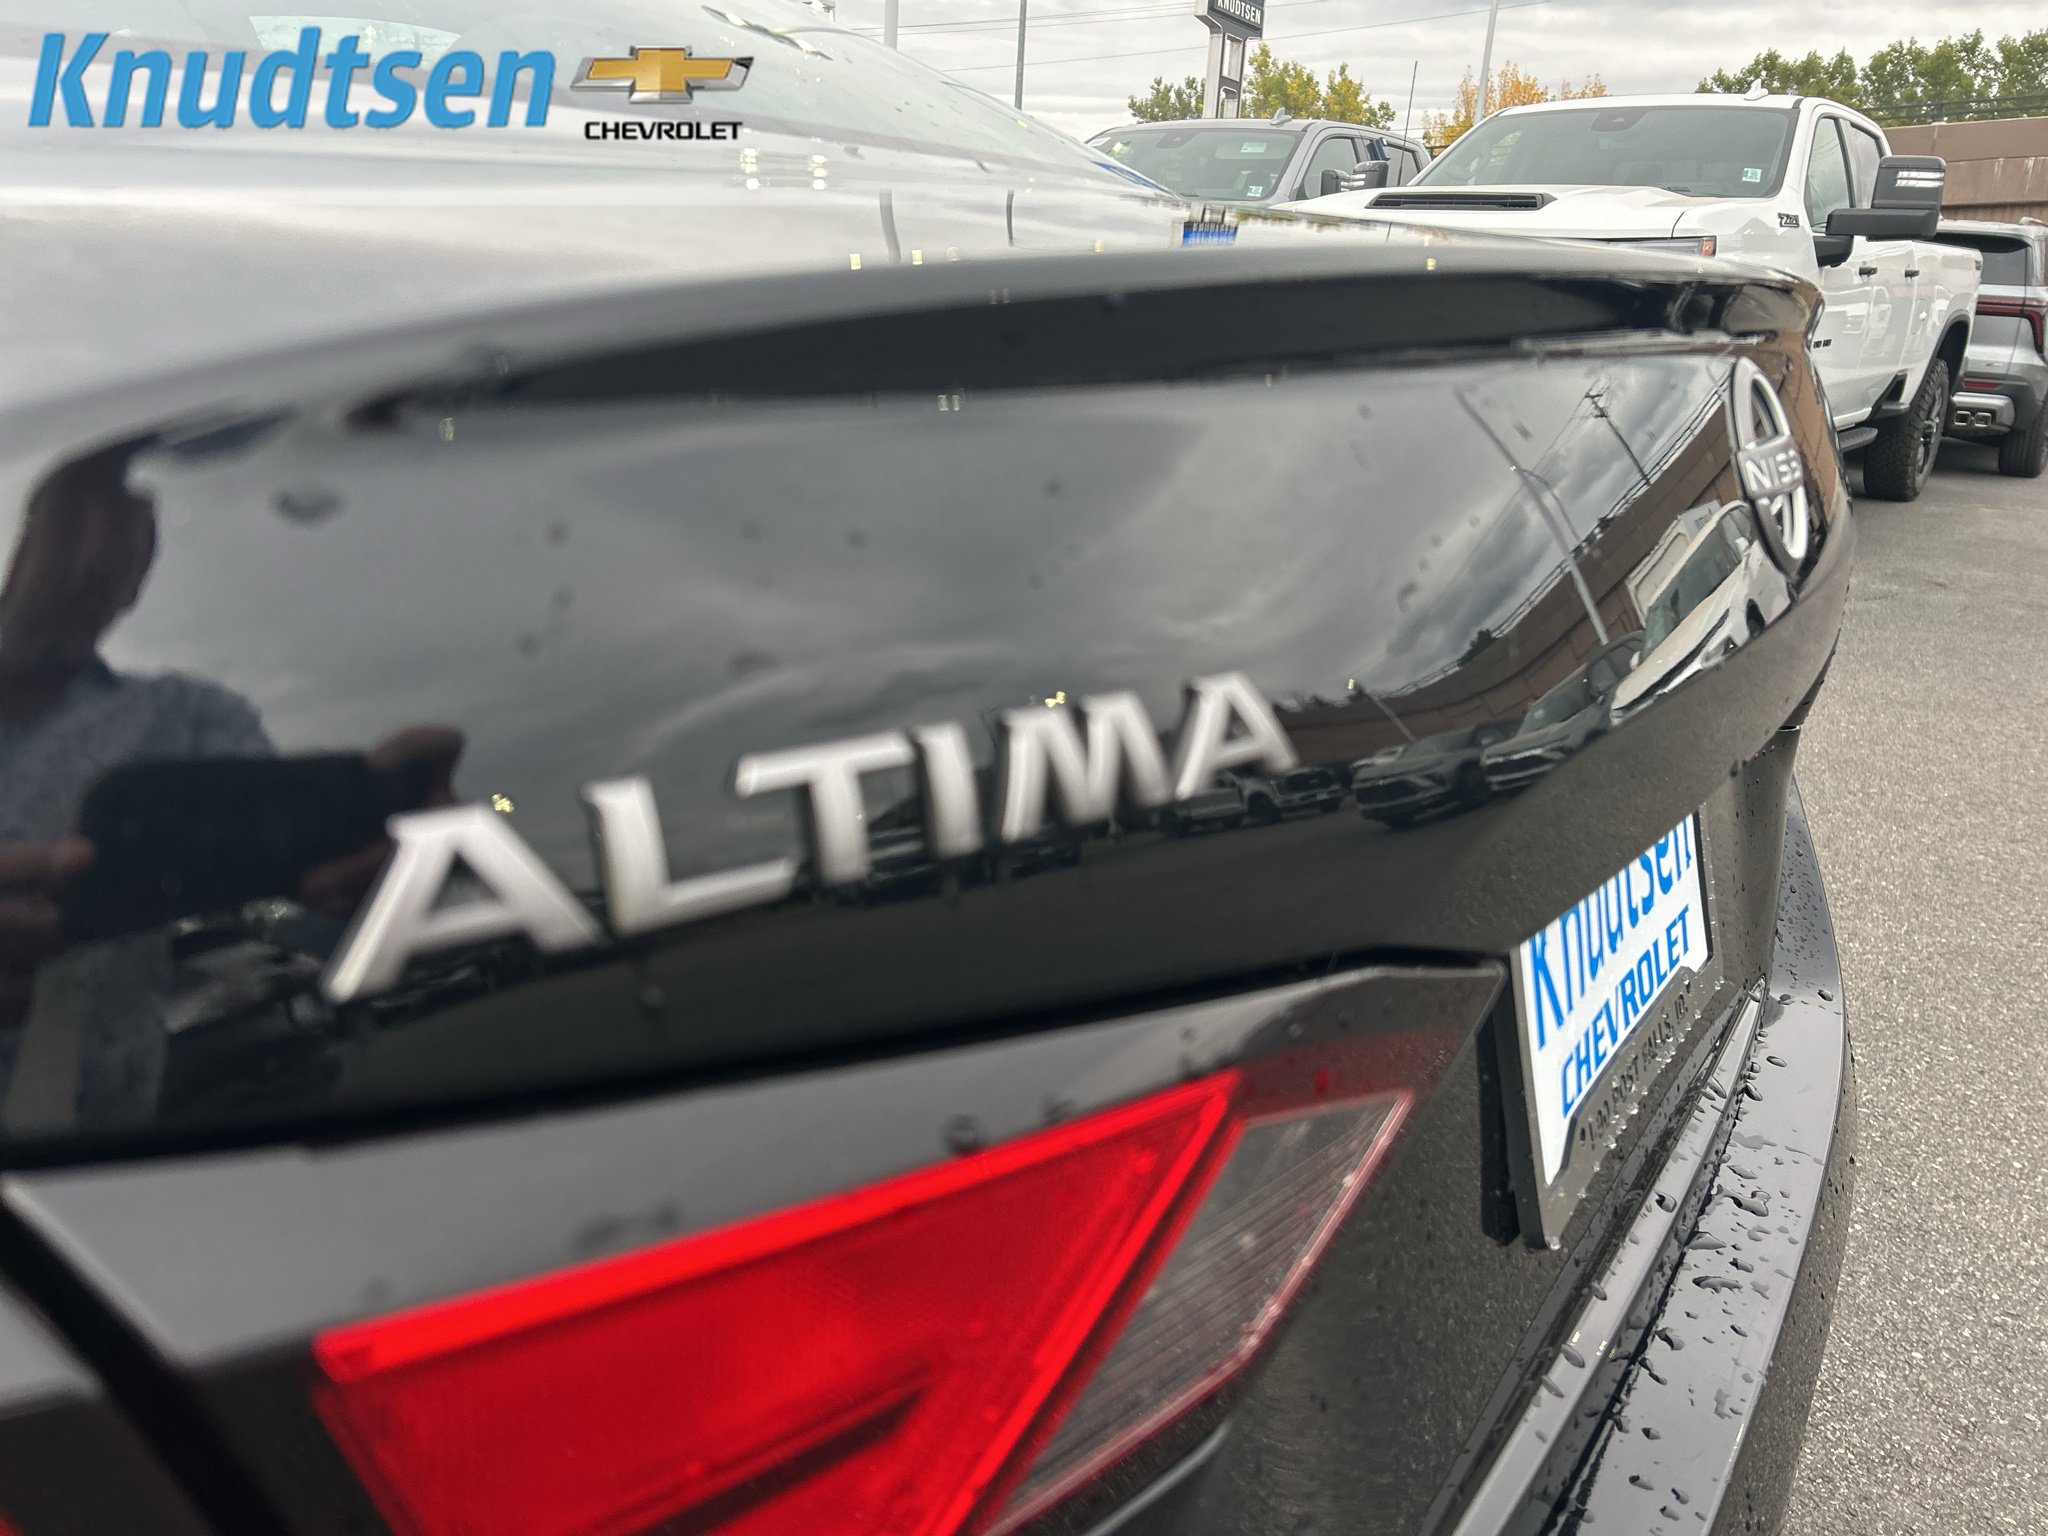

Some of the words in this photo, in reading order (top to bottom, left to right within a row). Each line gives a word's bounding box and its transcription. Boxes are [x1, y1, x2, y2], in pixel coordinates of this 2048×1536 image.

[1217, 0, 1261, 24] KNUDTSEN
[322, 672, 1300, 1002] ALTIMA
[1561, 903, 1690, 1119] CHEVROLET
